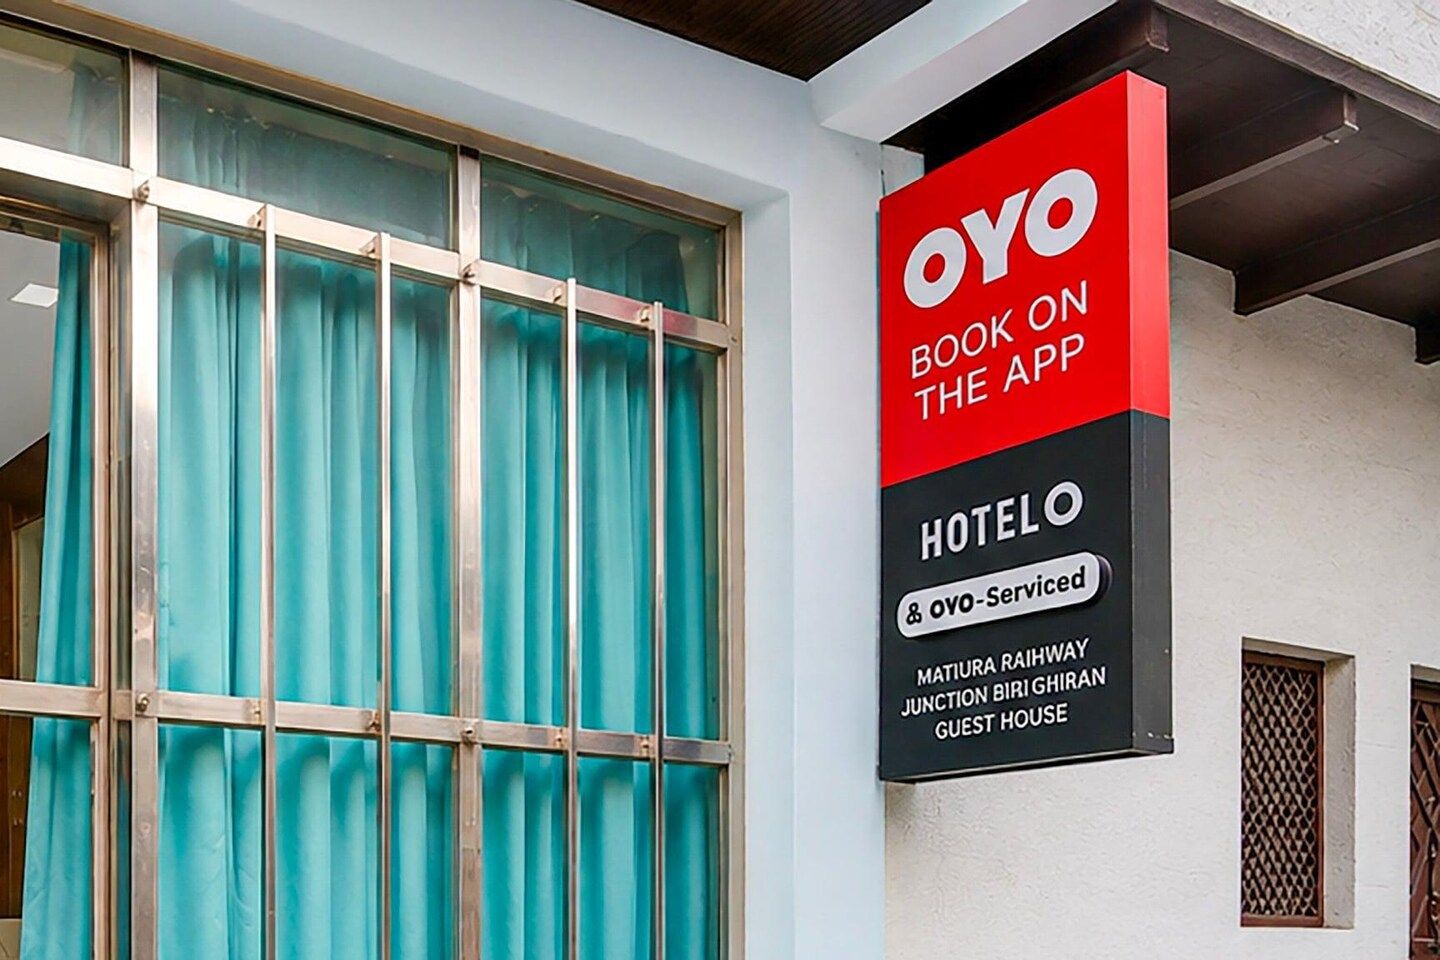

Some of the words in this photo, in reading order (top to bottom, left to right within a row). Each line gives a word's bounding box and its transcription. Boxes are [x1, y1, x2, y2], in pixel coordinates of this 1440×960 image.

[904, 168, 1098, 308] OYO
[911, 309, 1013, 379] BOOK
[1028, 280, 1087, 331] ON
[914, 367, 988, 420] THE
[1003, 333, 1085, 392] APP
[905, 603, 922, 625] &
[901, 687, 988, 716] JUNCTION
[935, 714, 995, 740] GUEST
[1000, 703, 1068, 730] HOUSE
